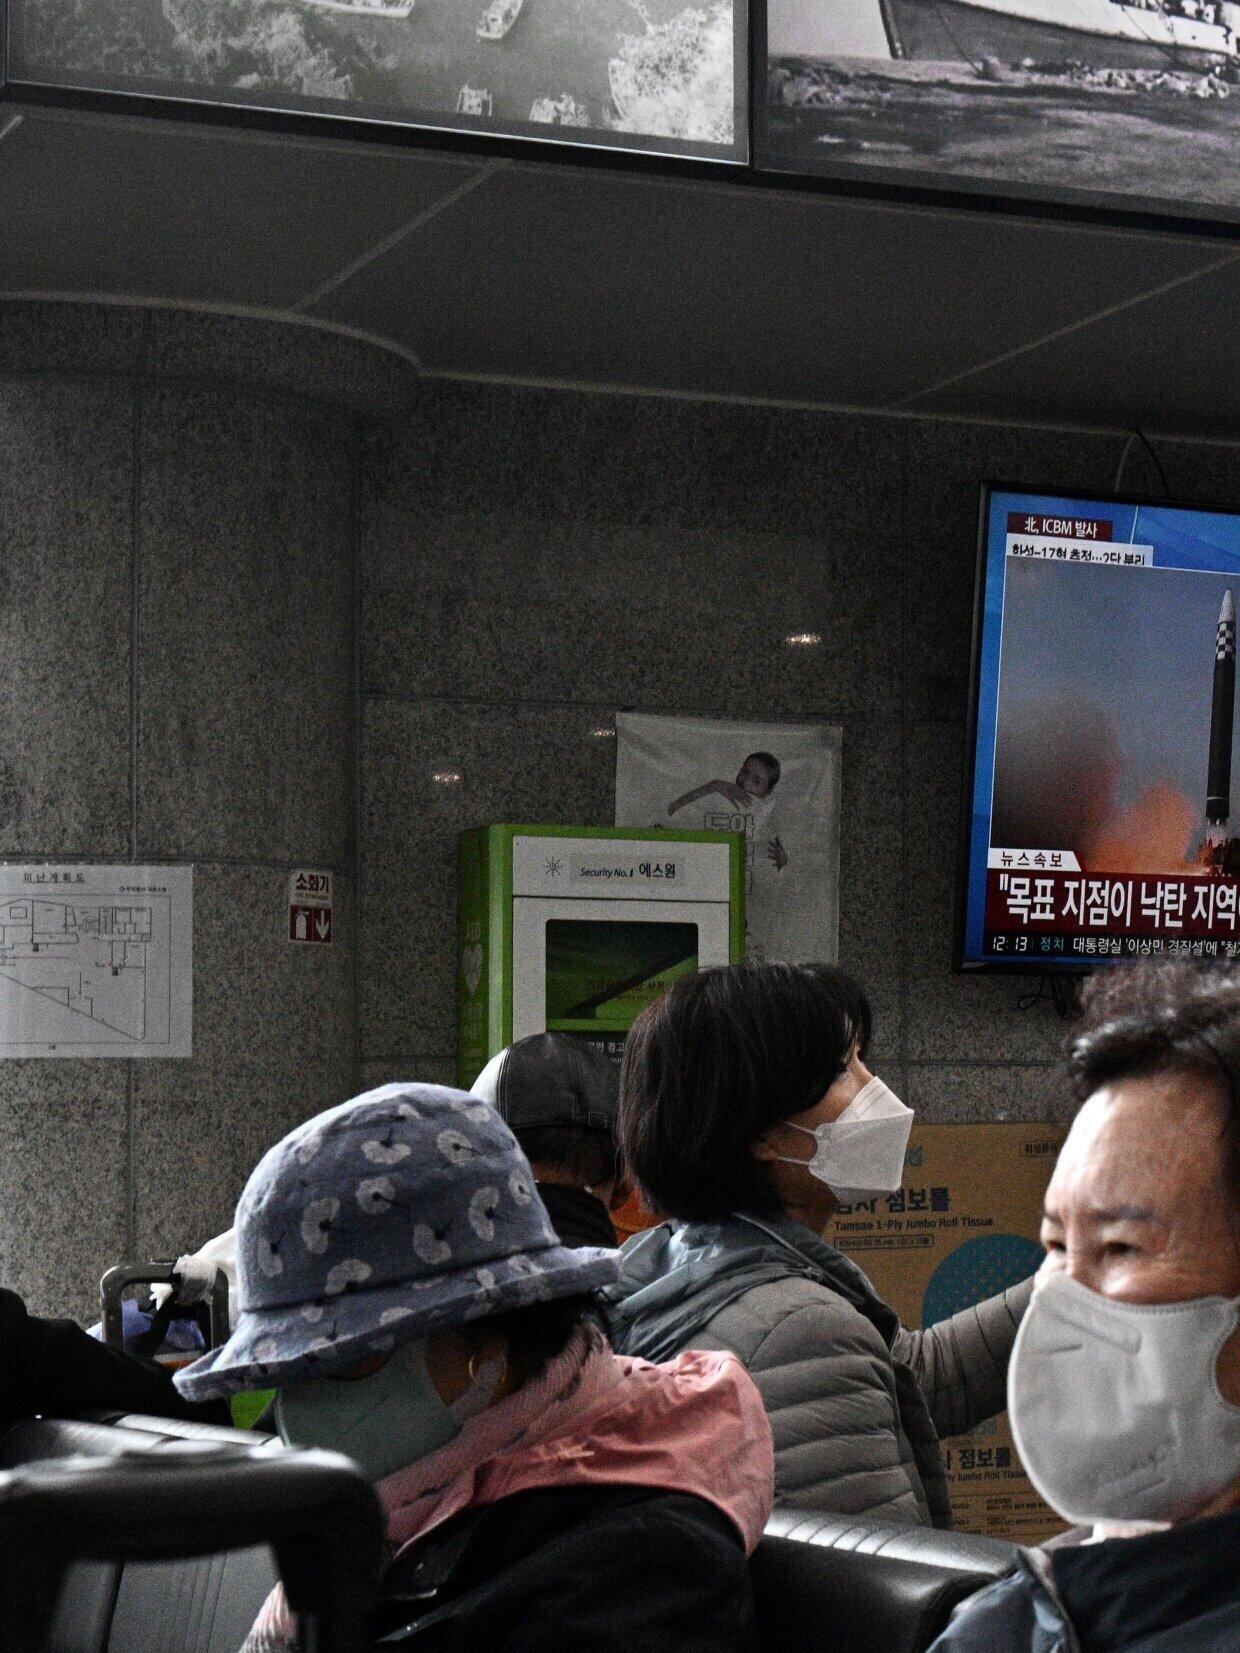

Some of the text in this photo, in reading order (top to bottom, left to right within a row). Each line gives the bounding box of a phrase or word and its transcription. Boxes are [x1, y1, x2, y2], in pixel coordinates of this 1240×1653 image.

[1042, 518, 1072, 535] ICBM
[1075, 520, 1098, 538] 발사
[1000, 851, 1063, 868] 뉴스속보
[580, 866, 612, 879] Security
[638, 862, 676, 878] 에스원
[295, 873, 330, 893] 소화기
[999, 873, 1056, 926] "목표
[1061, 879, 1133, 927] 지점이
[1140, 882, 1187, 928] 낙탄
[1040, 937, 1064, 953] 정치
[1072, 937, 1122, 953] 대통령실
[1125, 937, 1163, 954] '이상민
[906, 1218, 936, 1230] Jumbo
[939, 1217, 958, 1228] Roll
[961, 1216, 994, 1227] Tissue
[960, 1448, 1012, 1469] 점보롤
